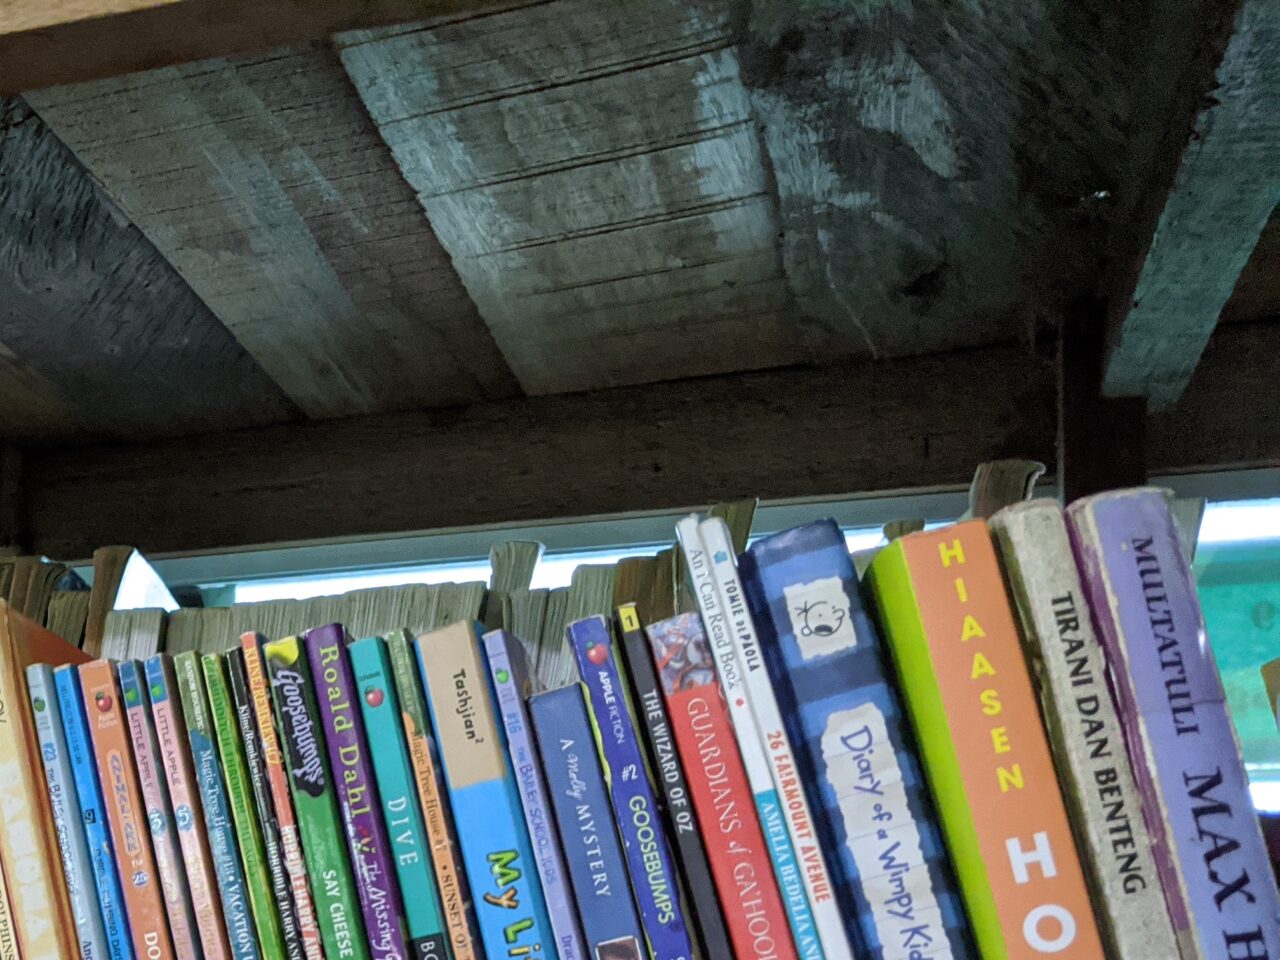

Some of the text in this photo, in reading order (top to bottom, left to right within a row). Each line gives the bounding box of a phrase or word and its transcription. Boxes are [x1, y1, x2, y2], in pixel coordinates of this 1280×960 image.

[937, 539, 1025, 793] HIASEN
[1132, 536, 1200, 736] MULTATULI
[319, 645, 352, 733] Roald
[338, 745, 371, 819] Dahl
[643, 689, 693, 833] THE WIZARD OF OZ
[688, 698, 742, 833] GUARDIANS
[1051, 590, 1147, 895] TIRANI DAN BENTENG
[323, 870, 341, 897] SAY
[388, 796, 419, 866] DIVE
[483, 849, 522, 908] My
[629, 795, 675, 925] GOOSEBUMPS
[762, 802, 787, 862] AMELIA
[780, 865, 811, 934] BEDELIA
[767, 731, 831, 903] 26 FAIRMOUNT AVENUE
[841, 725, 884, 798] Diary
[878, 841, 914, 921] Wimpy
[1182, 765, 1258, 914] MAX
[329, 903, 353, 958] CHEESE
